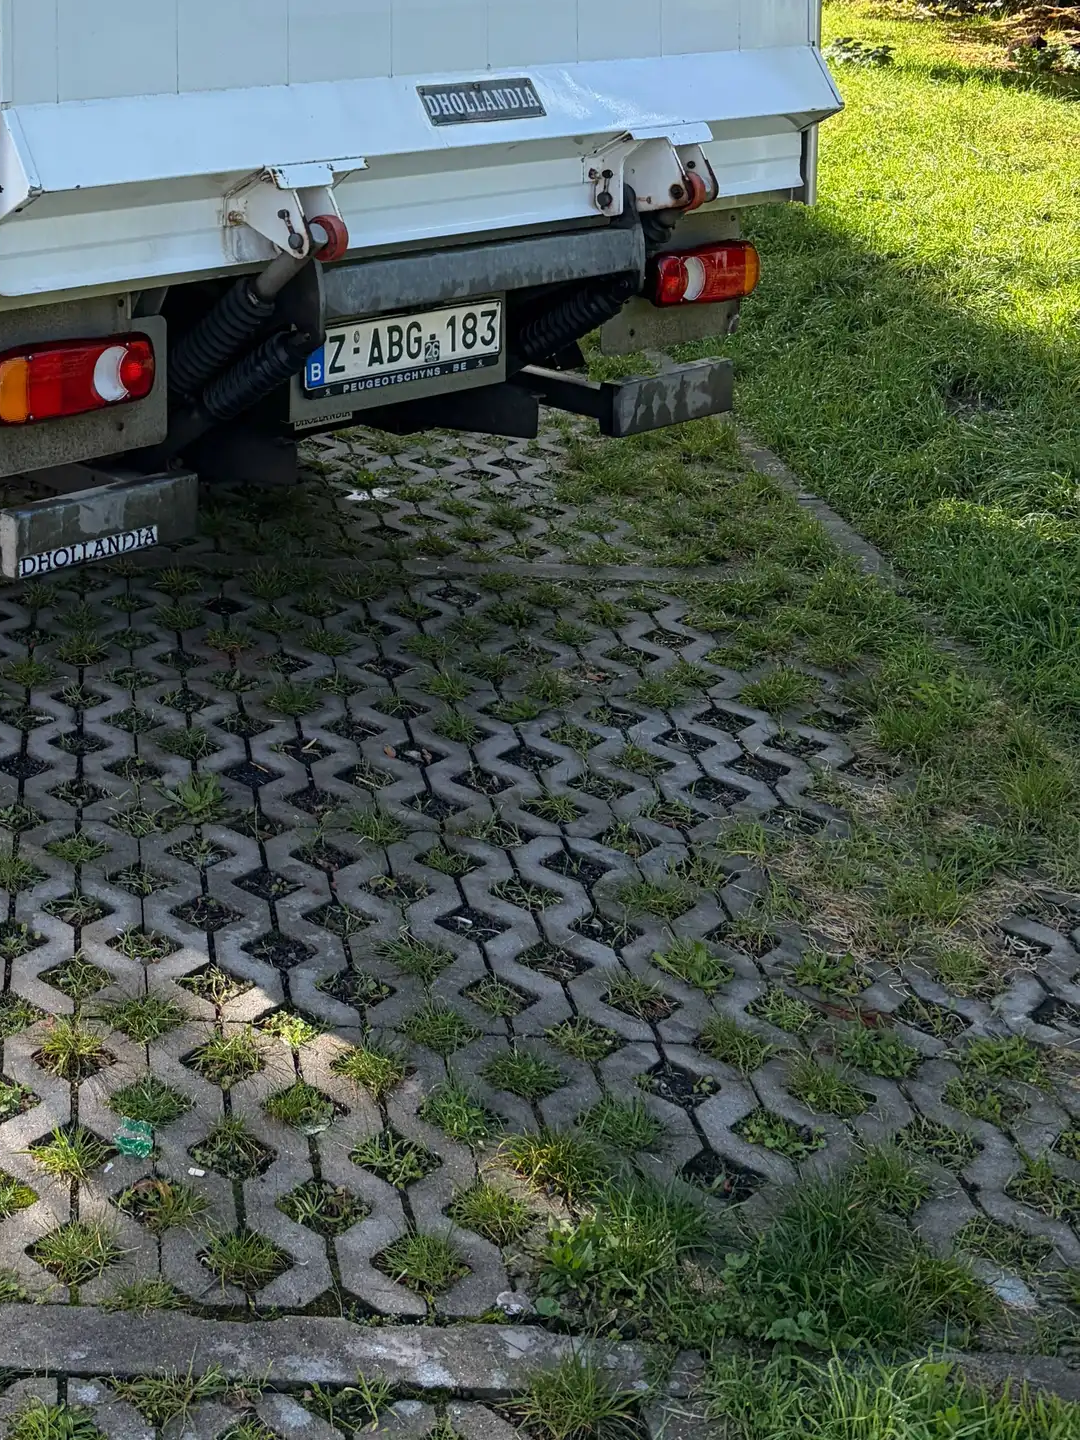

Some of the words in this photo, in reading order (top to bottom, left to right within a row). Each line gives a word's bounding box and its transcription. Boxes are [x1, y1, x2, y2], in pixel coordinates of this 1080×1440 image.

[424, 86, 540, 117] DHOLLANDIA
[311, 363, 322, 382] B
[20, 525, 158, 577] DHOLLANDIA
